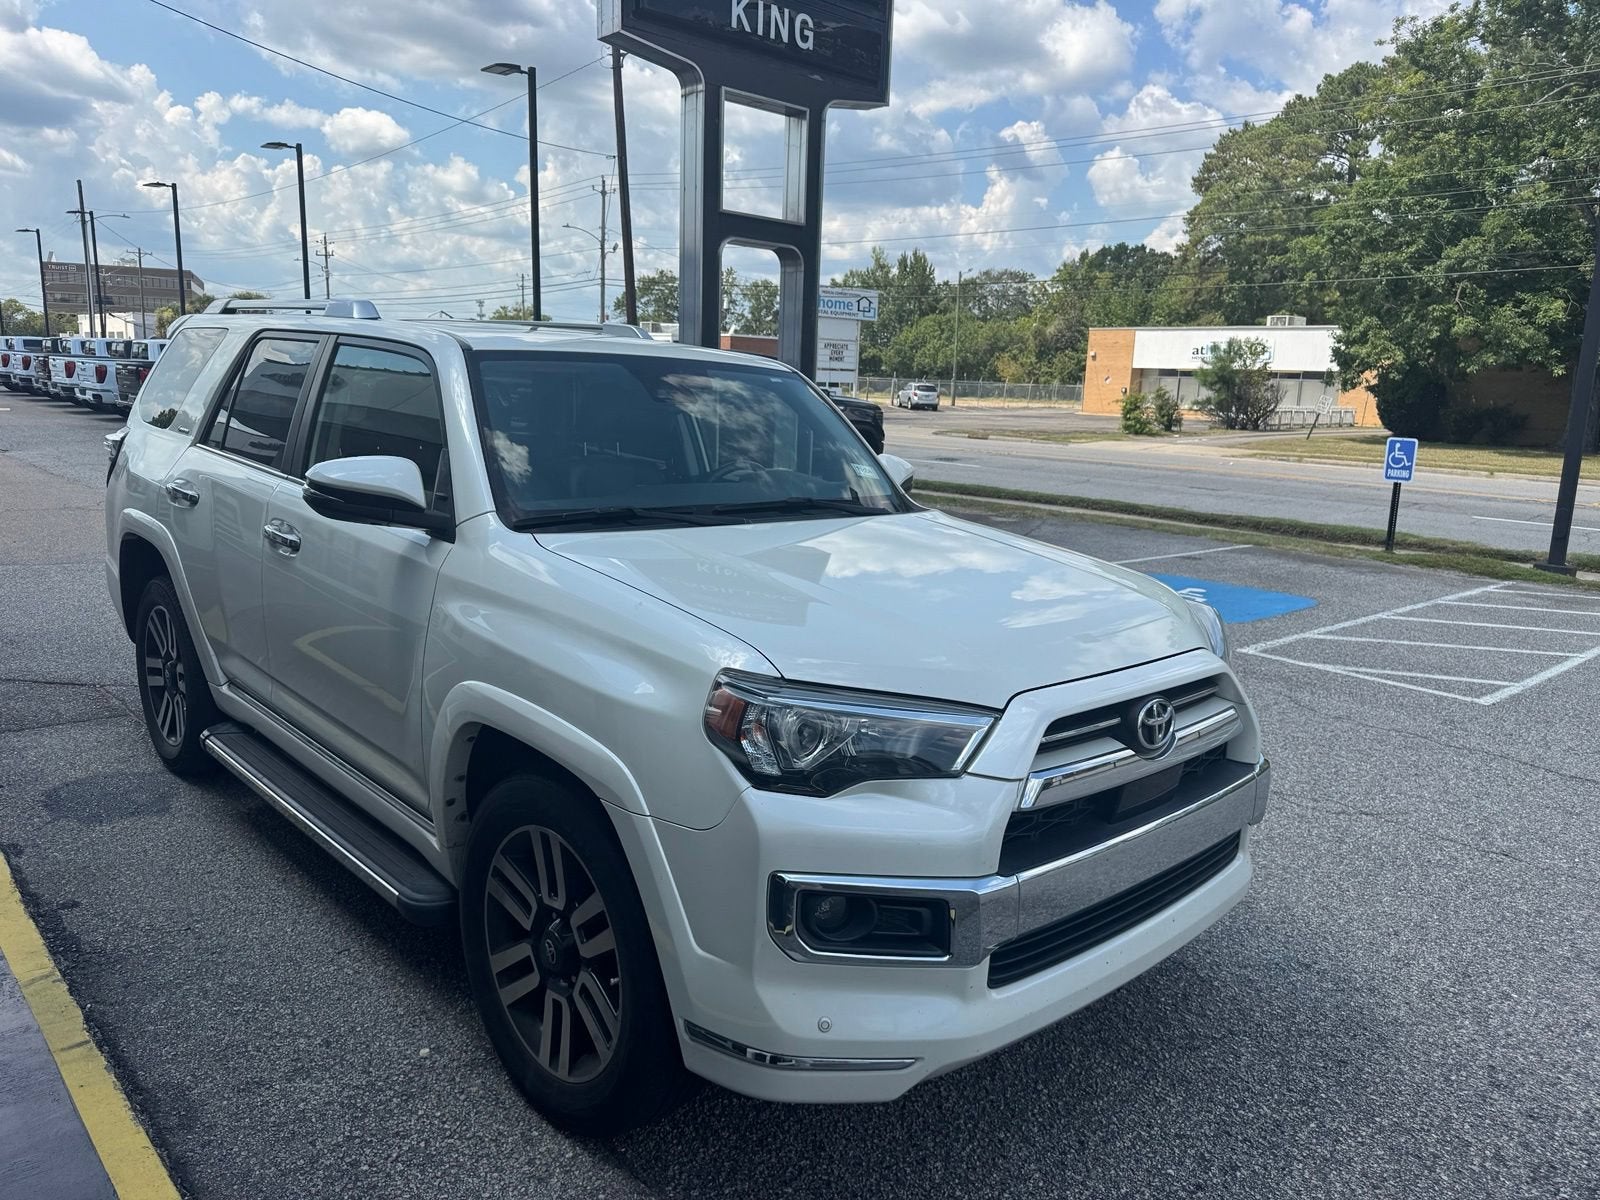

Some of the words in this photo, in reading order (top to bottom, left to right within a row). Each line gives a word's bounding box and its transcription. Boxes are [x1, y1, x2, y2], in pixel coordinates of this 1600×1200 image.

[731, 0, 814, 50] KING
[824, 342, 848, 350] APPRECIATE
[1387, 469, 1410, 478] PARKING
